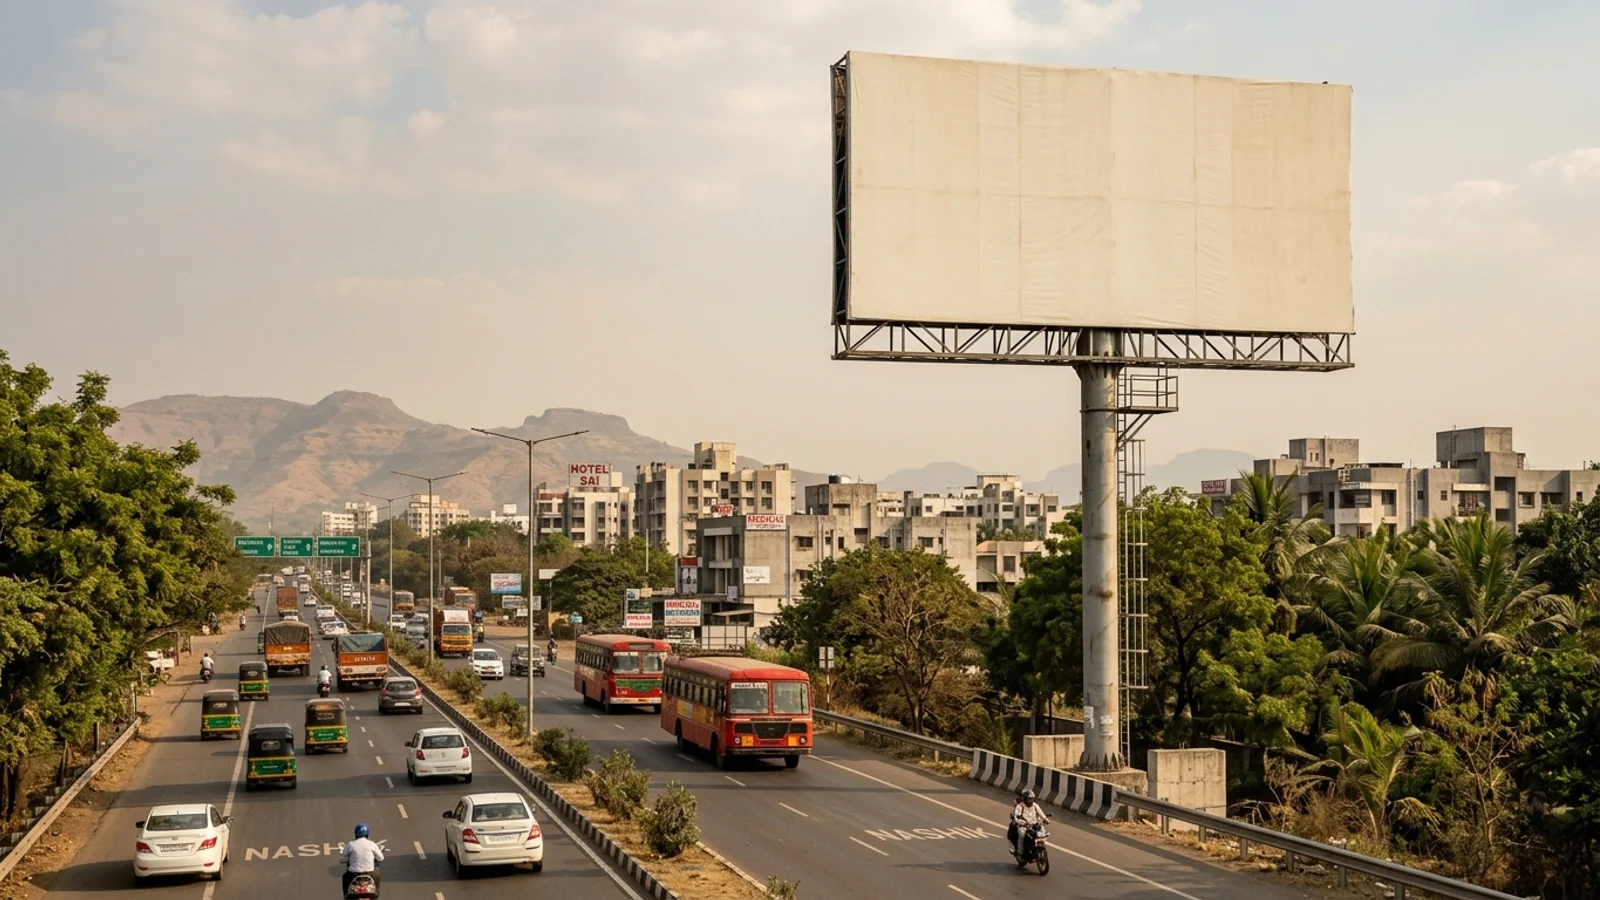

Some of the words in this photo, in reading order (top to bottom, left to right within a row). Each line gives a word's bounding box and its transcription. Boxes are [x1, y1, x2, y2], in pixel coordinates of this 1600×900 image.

[570, 464, 609, 474] HOTEL
[579, 475, 599, 486] SAI
[863, 826, 1003, 841] NASHIK
